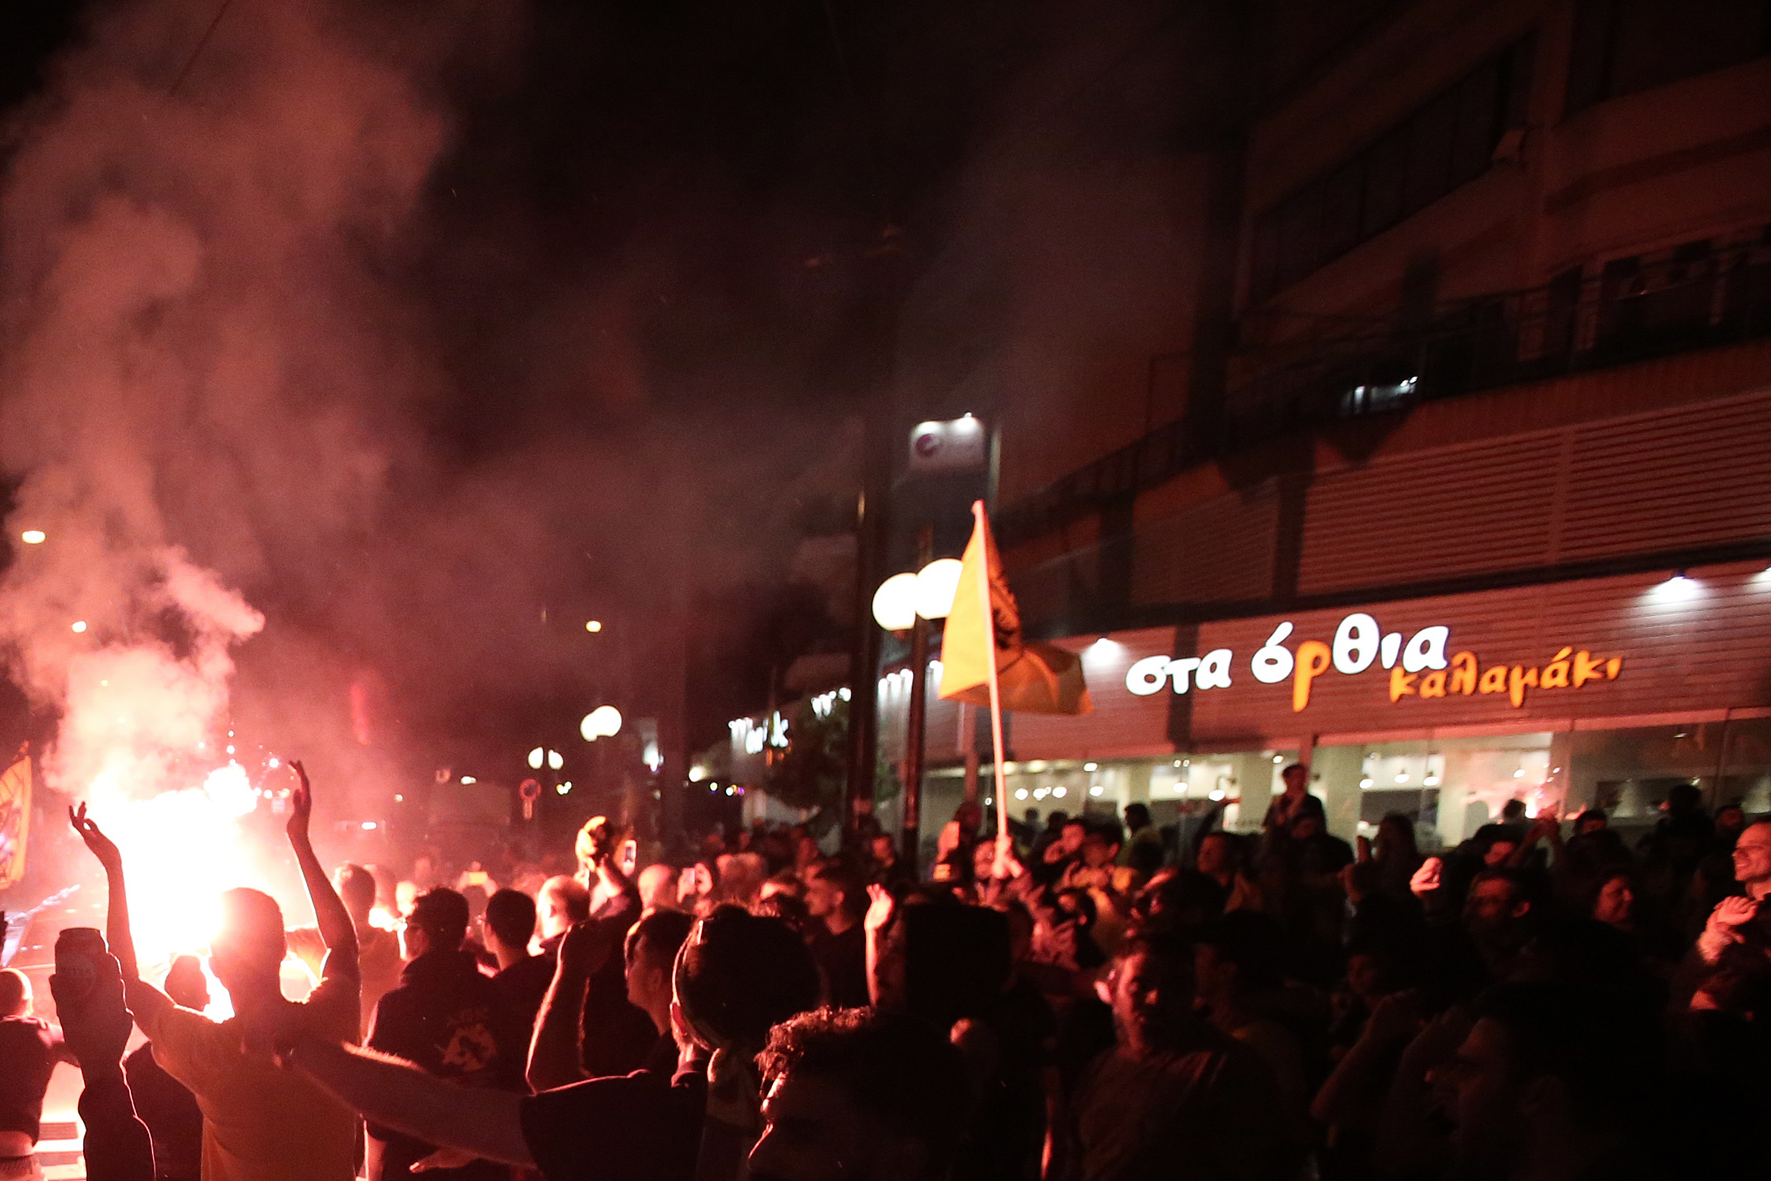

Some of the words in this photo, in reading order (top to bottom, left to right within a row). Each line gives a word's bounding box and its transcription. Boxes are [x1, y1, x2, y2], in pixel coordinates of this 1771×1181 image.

[1125, 648, 1233, 696] στα
[1251, 612, 1449, 713] όρθια
[1389, 646, 1622, 709] καλαμάκι
